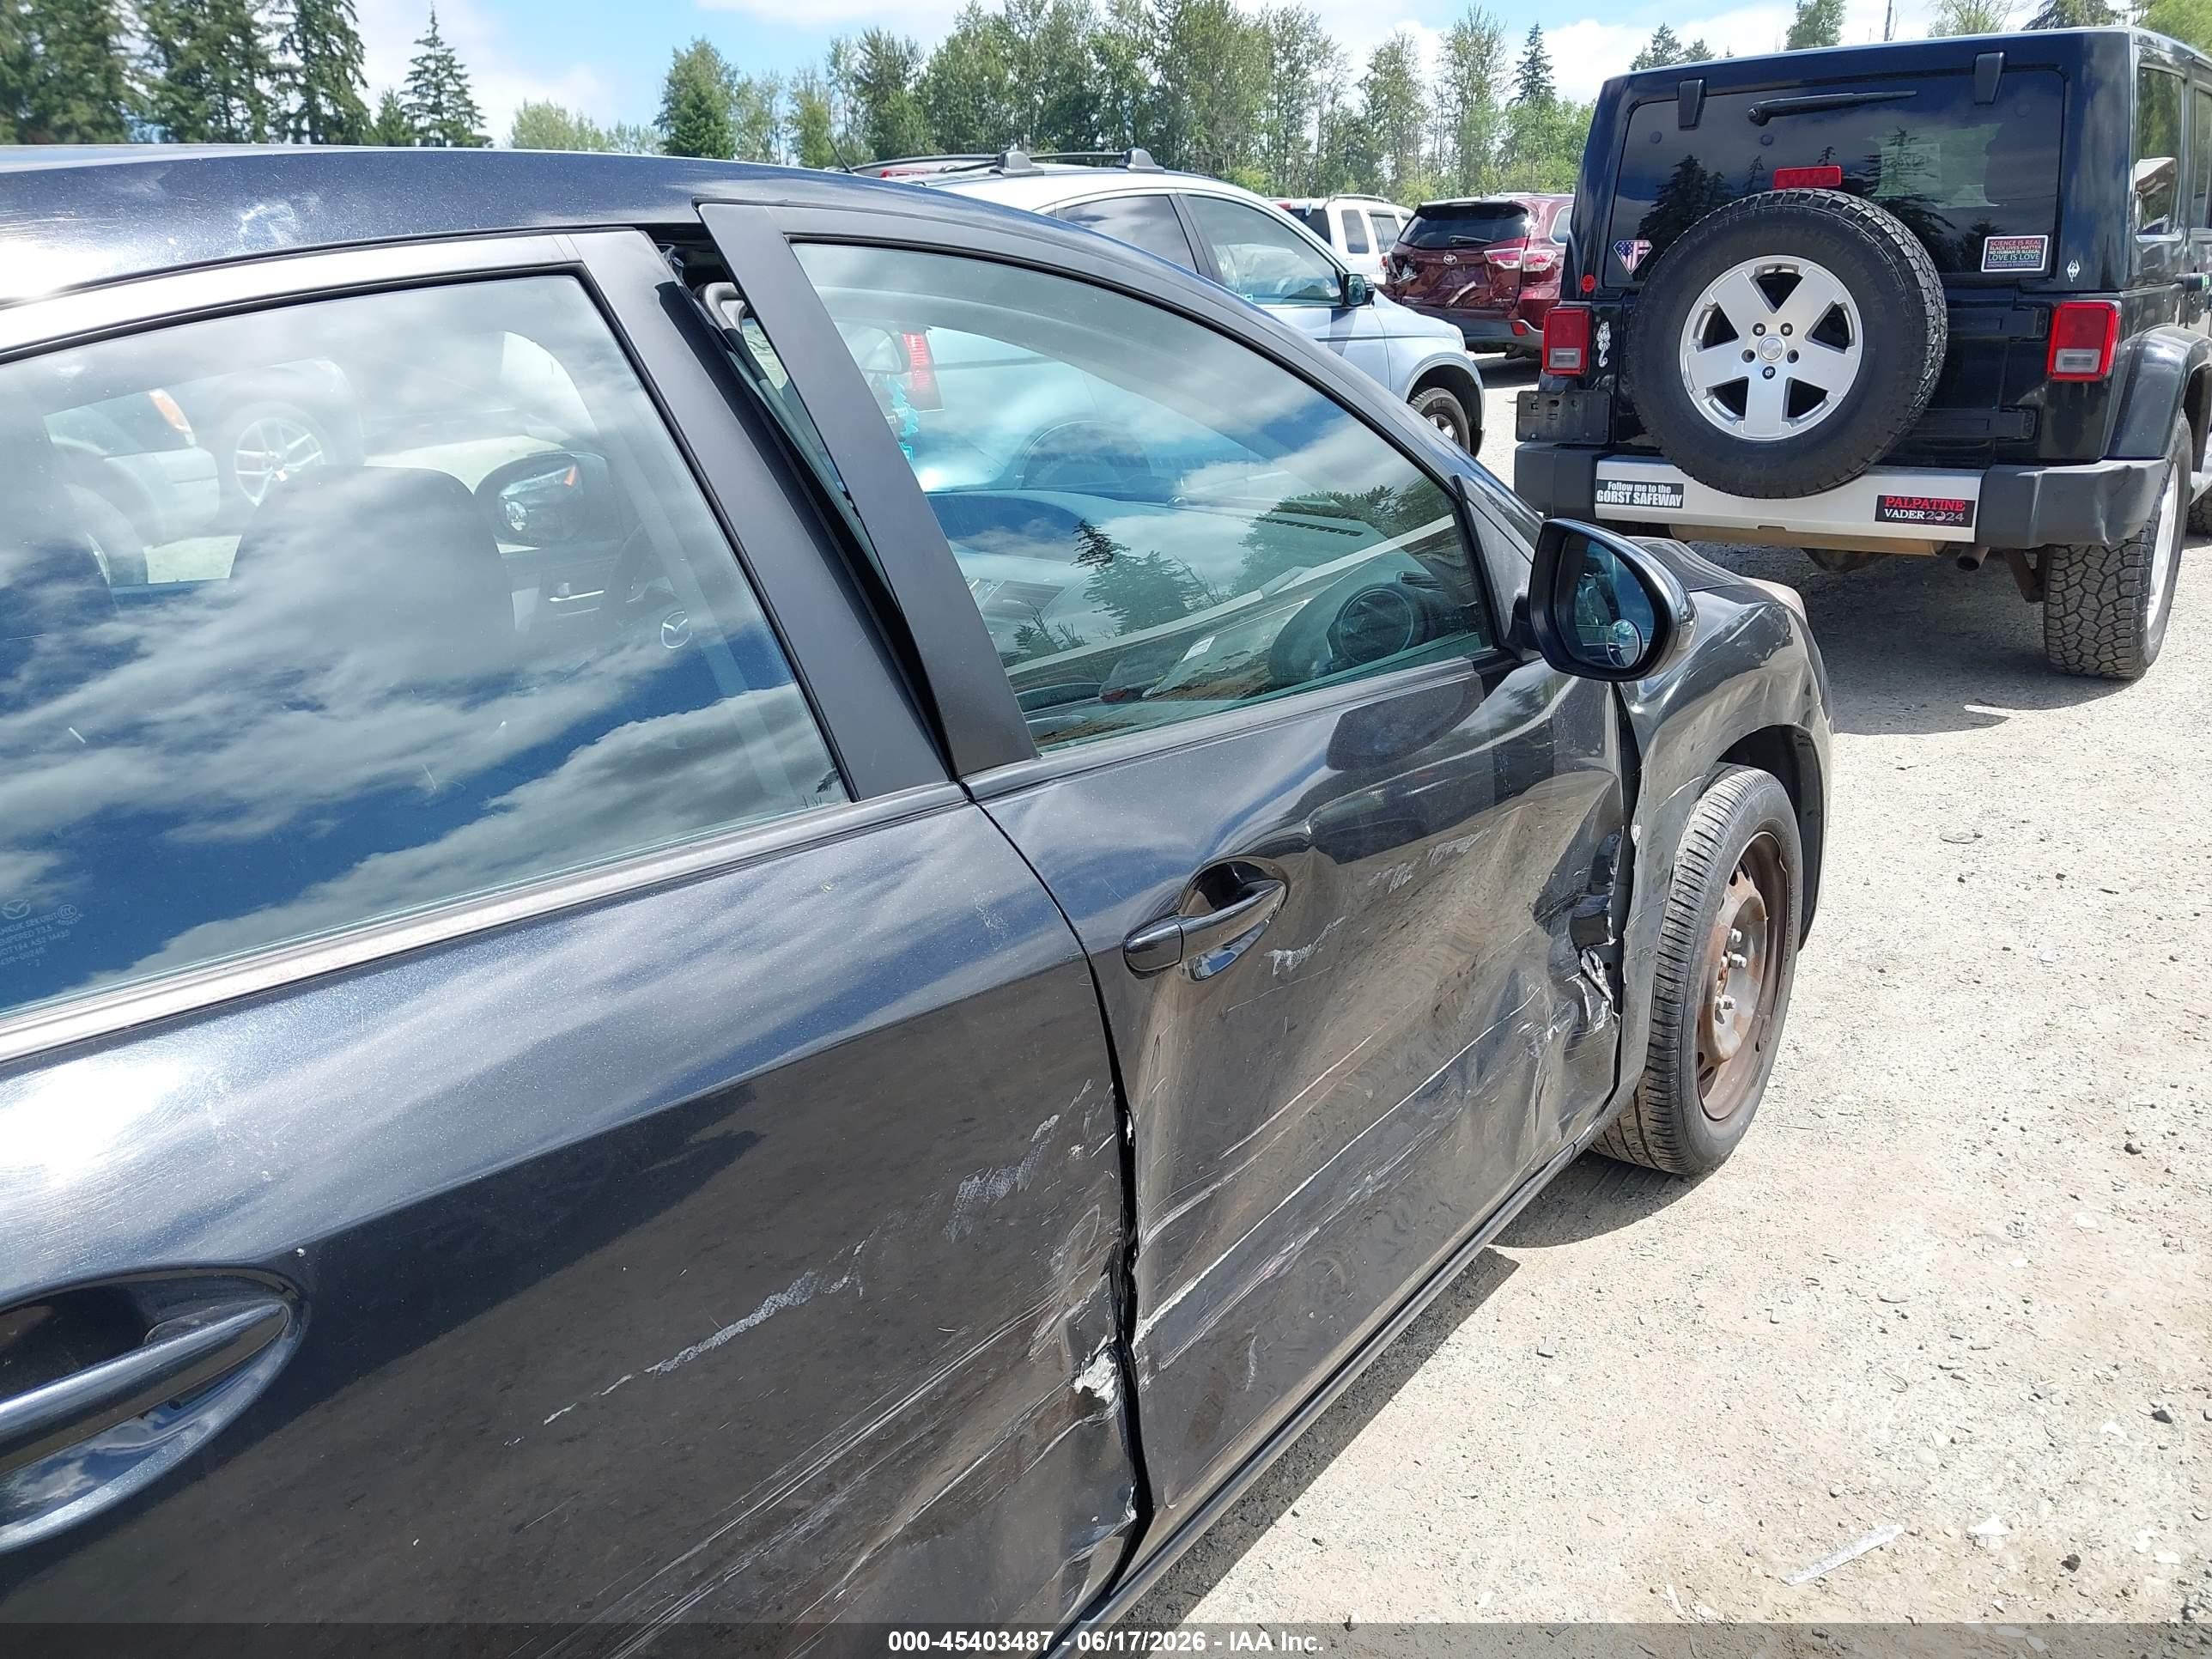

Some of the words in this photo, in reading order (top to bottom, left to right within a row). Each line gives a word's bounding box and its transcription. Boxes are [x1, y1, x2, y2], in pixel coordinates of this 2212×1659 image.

[1607, 481, 1633, 492] Follow
[1649, 484, 1656, 493] to
[1658, 484, 1671, 494] the
[1596, 490, 1632, 503] GORST
[1633, 492, 1682, 507] SAFEWAY
[1885, 496, 1966, 512] PALPATINE
[1884, 508, 1925, 520] VADER
